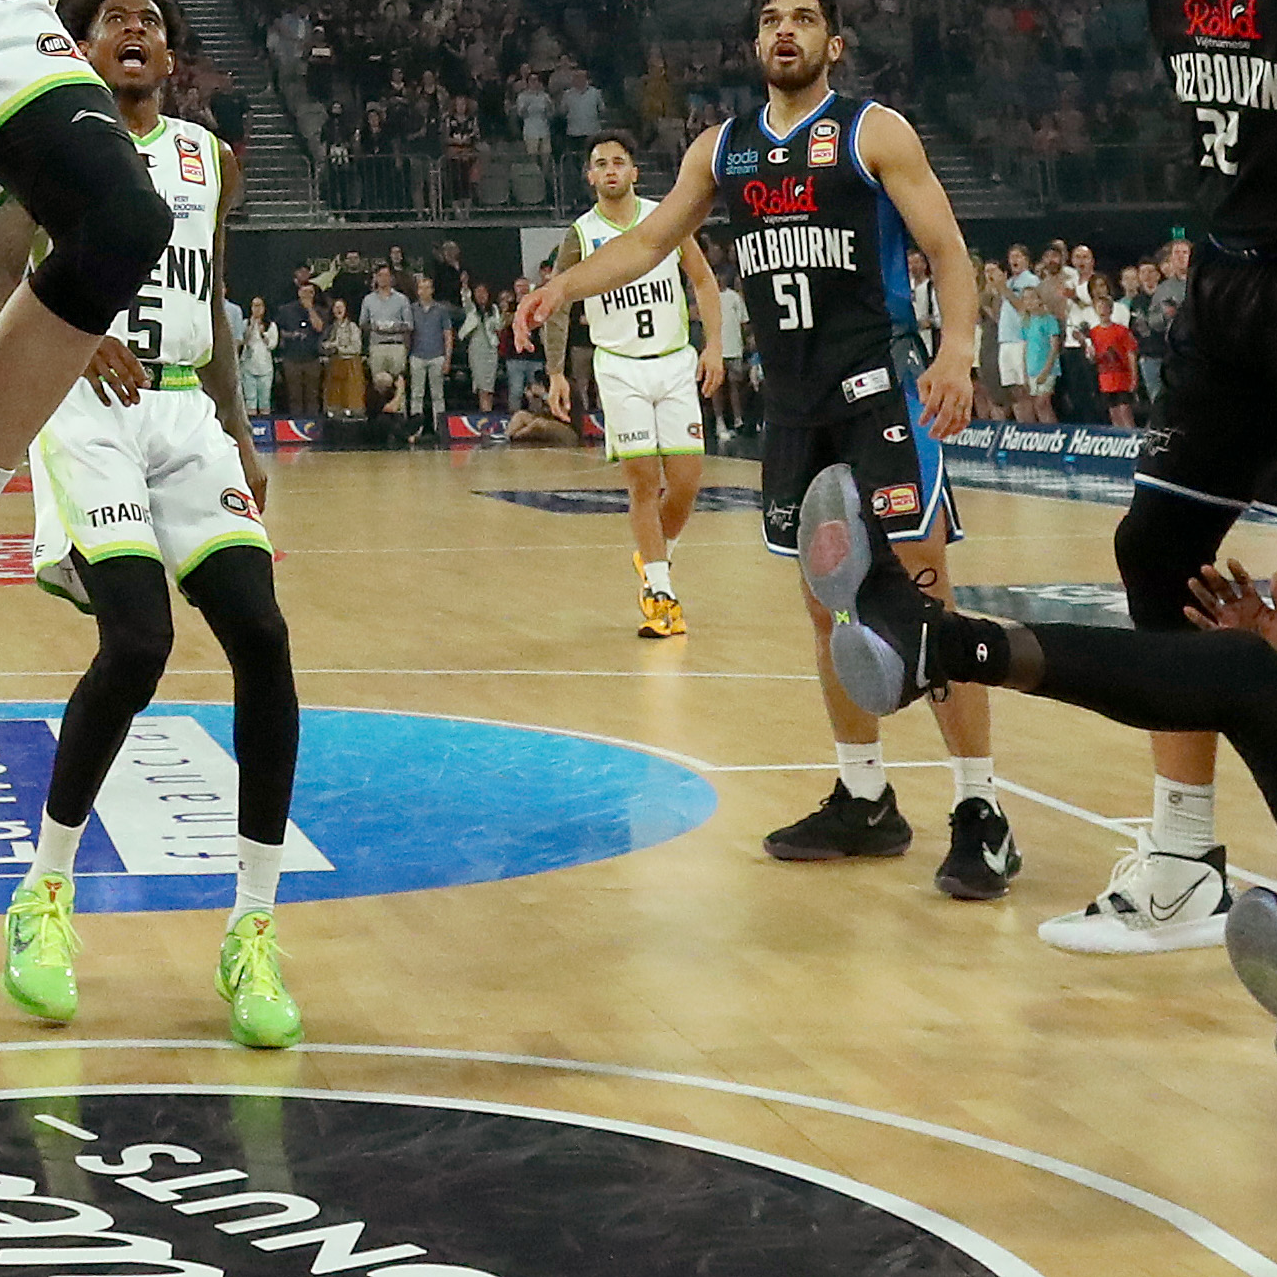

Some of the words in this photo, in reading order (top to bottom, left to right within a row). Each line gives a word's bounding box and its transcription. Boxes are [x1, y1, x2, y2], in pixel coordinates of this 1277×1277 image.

[726, 148, 759, 165] soda
[734, 225, 857, 279] MELBOURNE
[772, 272, 814, 331] 51
[635, 309, 655, 339] 8
[999, 425, 1068, 454] Harcourts
[1066, 427, 1143, 459] Harcourts
[74, 1143, 503, 1277] NUTS
